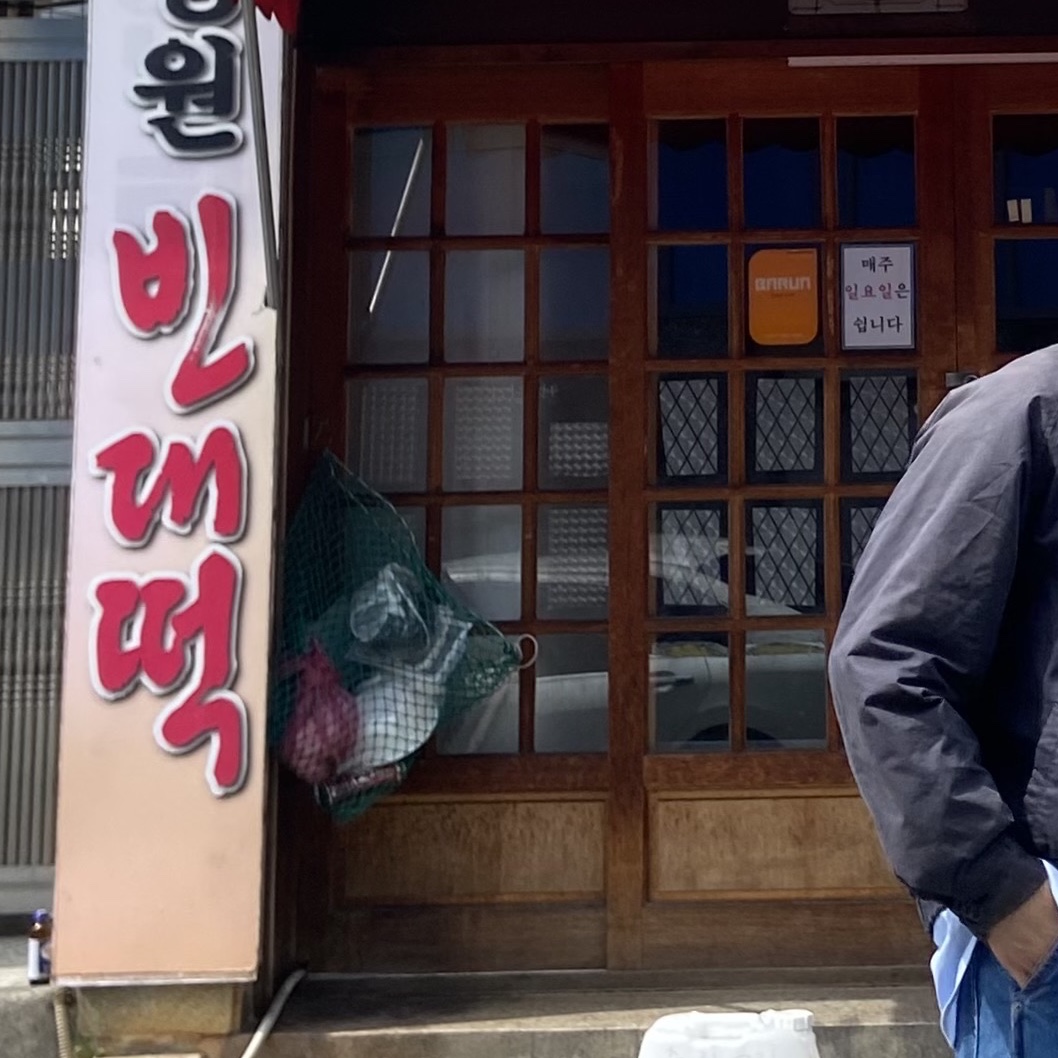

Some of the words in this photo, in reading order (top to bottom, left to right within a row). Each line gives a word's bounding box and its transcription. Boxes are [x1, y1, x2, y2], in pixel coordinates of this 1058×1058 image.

[861, 255, 894, 273] 매주
[845, 283, 910, 300] 일요일은
[853, 315, 903, 334] 쉽니다
[97, 194, 249, 789] 빈대떡
